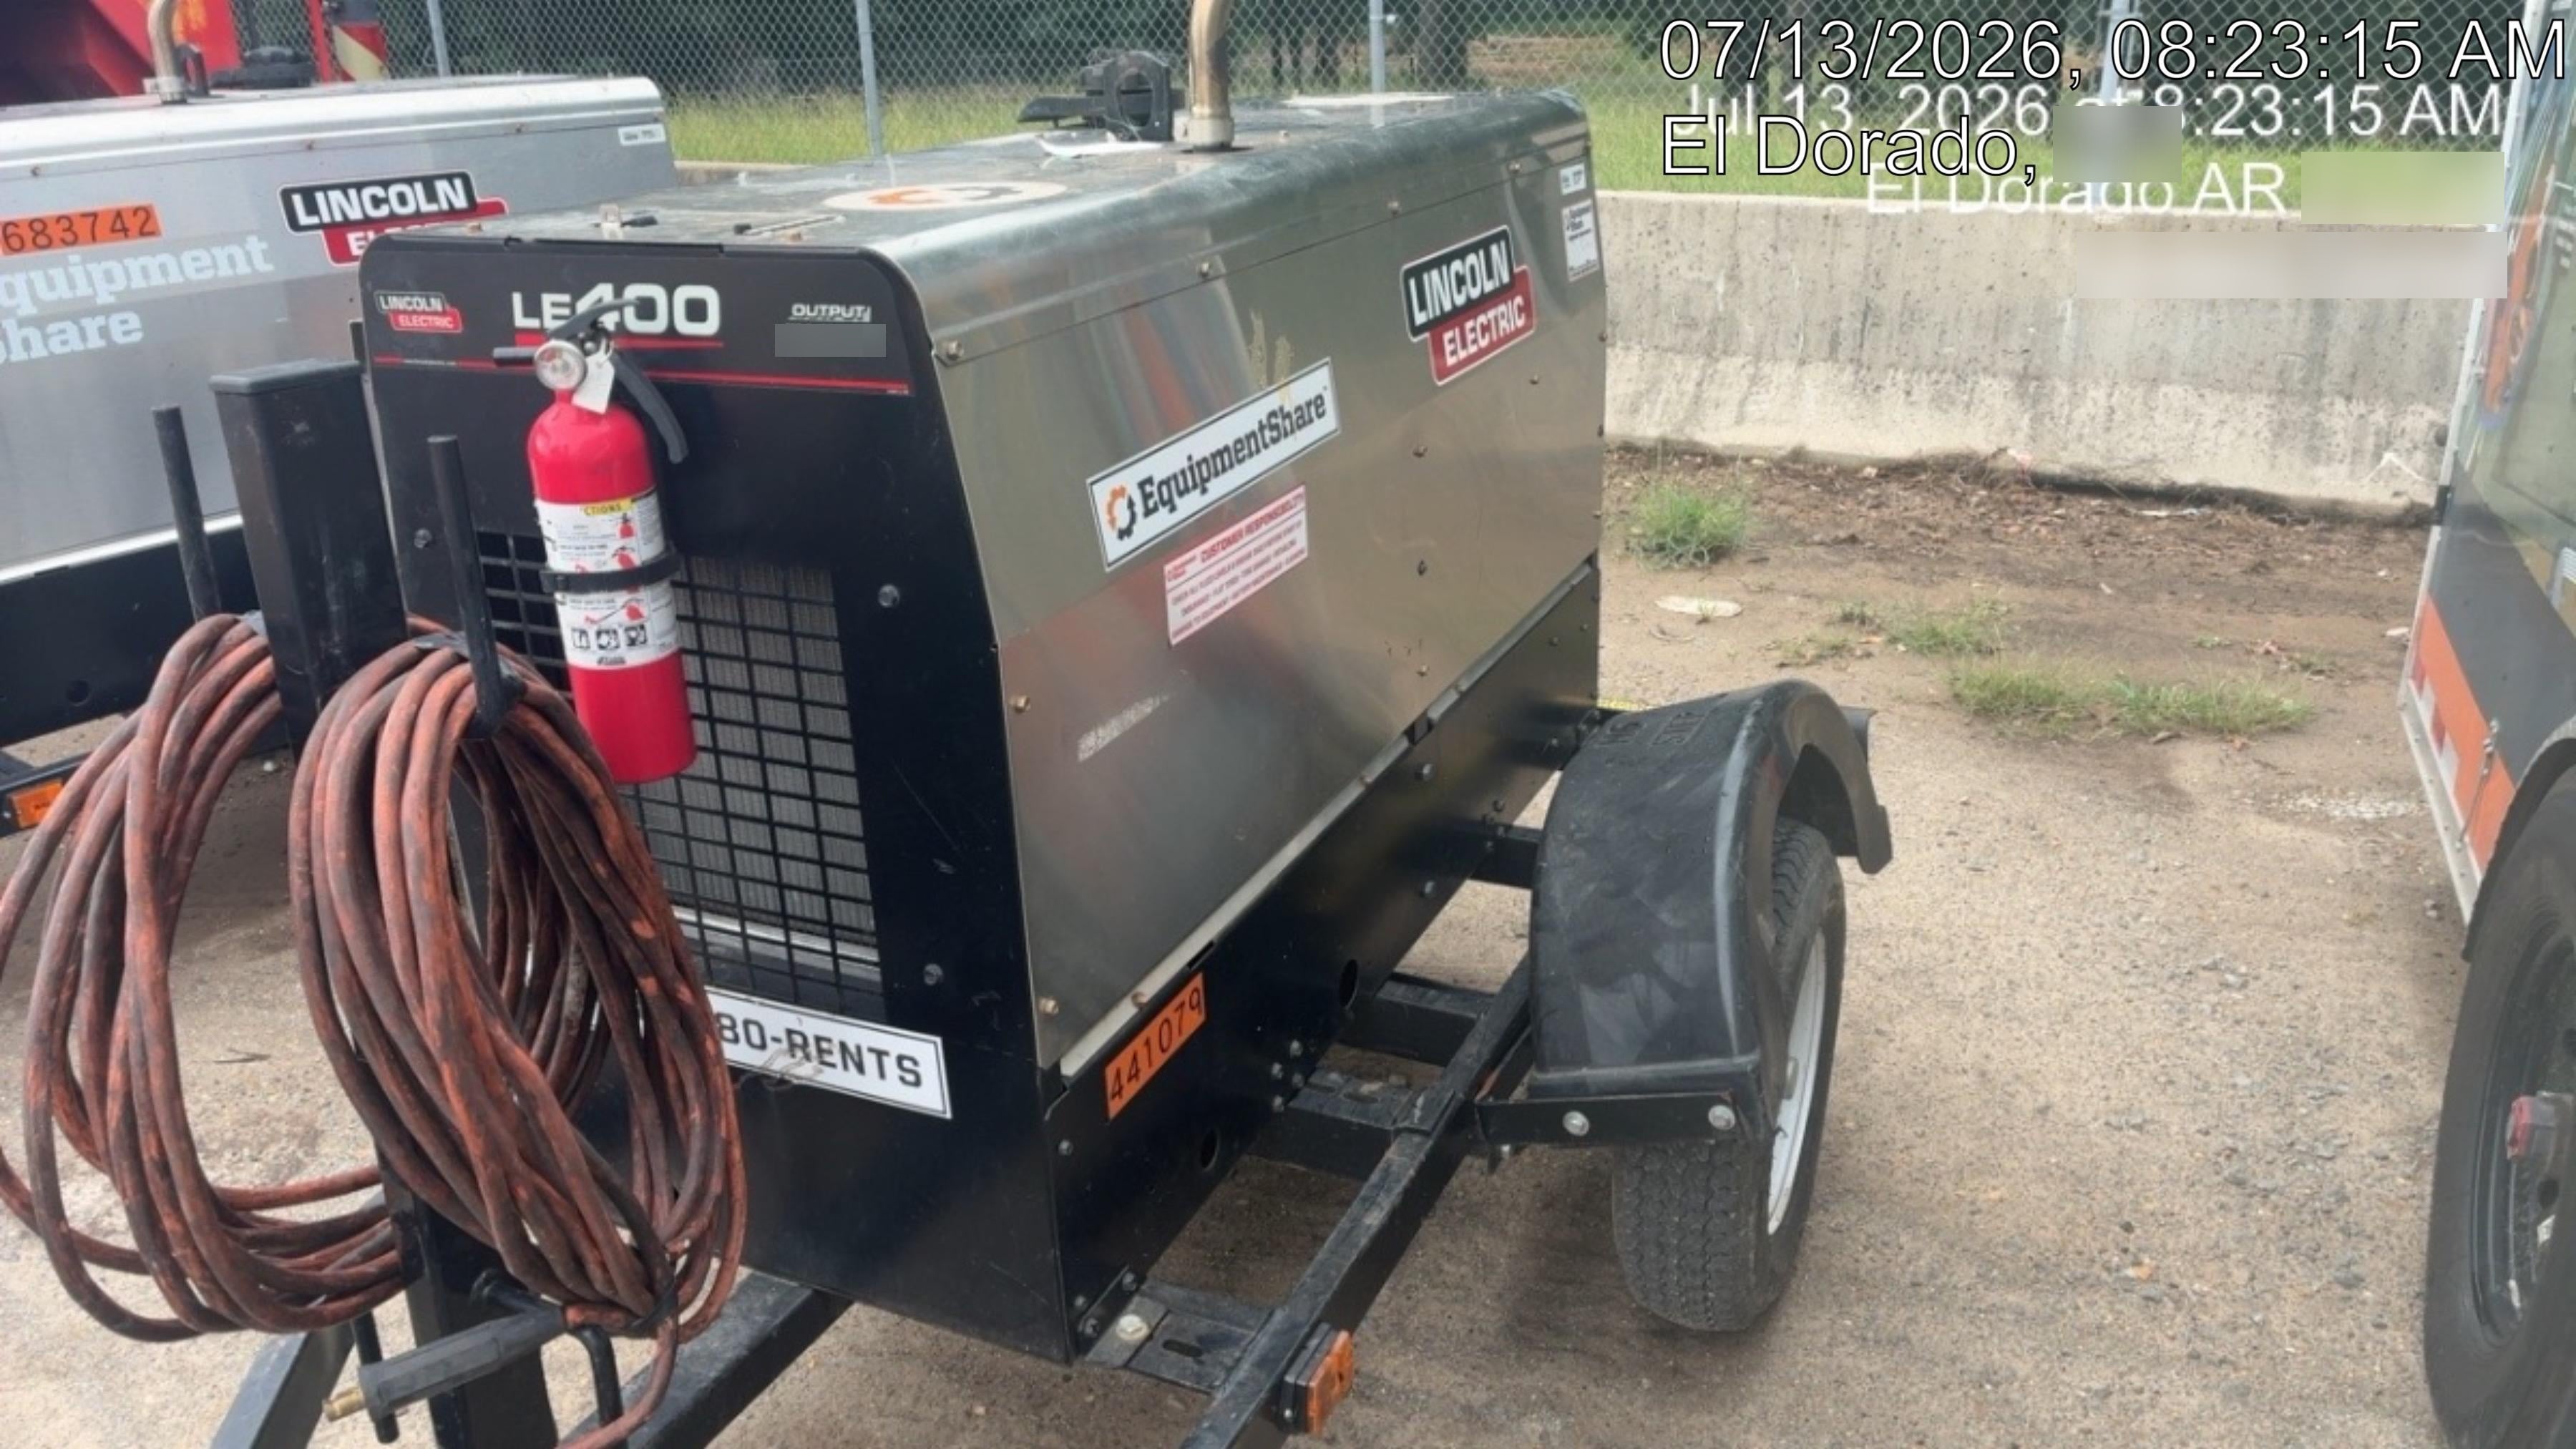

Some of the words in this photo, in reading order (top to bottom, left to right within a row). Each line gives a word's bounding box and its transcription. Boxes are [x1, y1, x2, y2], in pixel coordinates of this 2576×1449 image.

[291, 177, 469, 227] LINCOLN
[1, 205, 157, 253] 683742
[379, 295, 443, 313] LINCOLN
[511, 282, 721, 336] LE400
[1408, 240, 1511, 327] LINCOLN
[398, 313, 454, 329] ELECTRIC
[791, 303, 866, 318] OUTPUT
[1442, 295, 1526, 367] ELECTRIC
[0, 311, 144, 363] hare
[1137, 393, 1327, 519] EquipmentShare
[1111, 987, 1203, 1101] 441079
